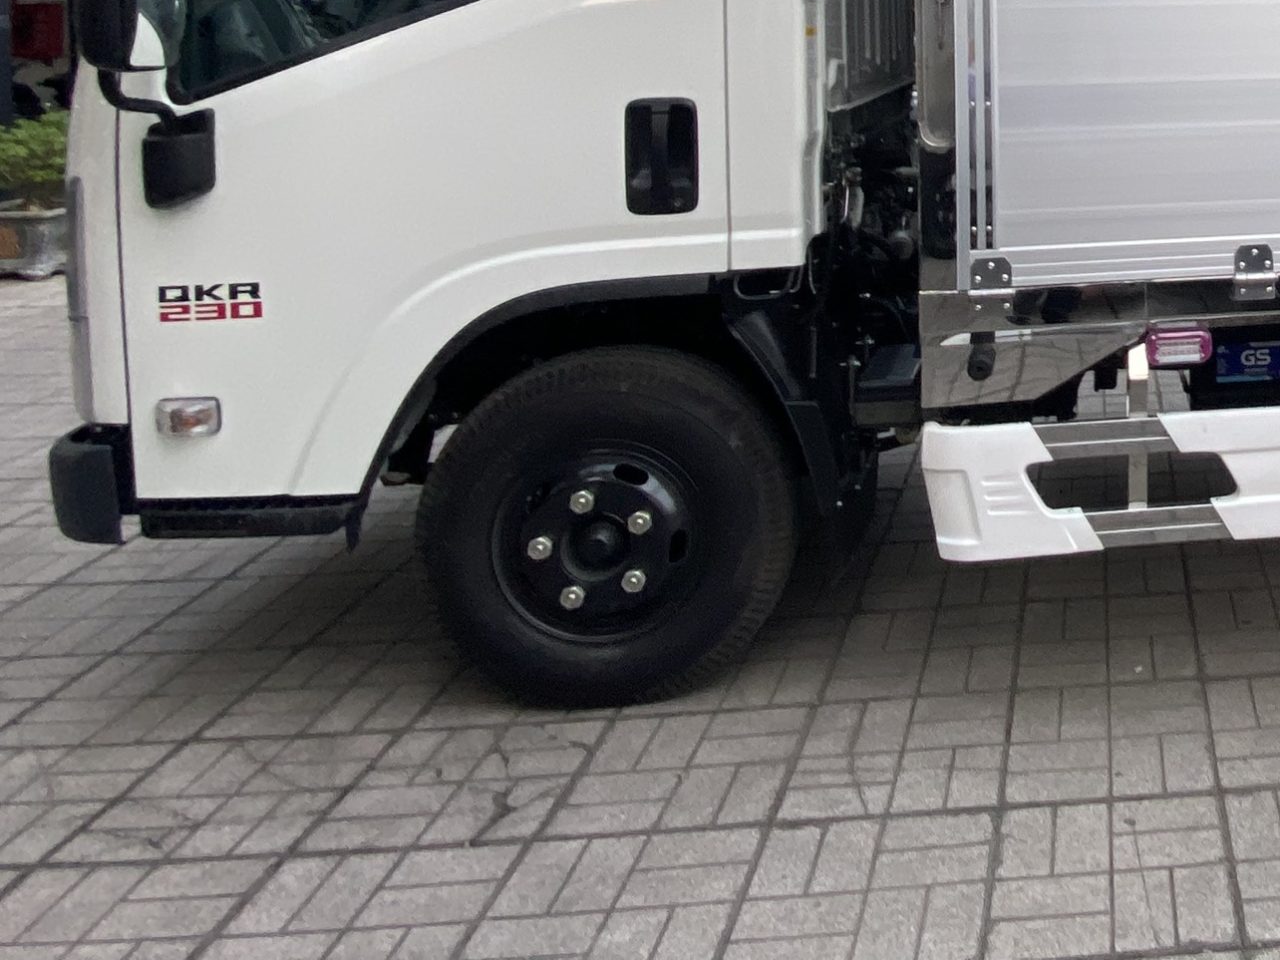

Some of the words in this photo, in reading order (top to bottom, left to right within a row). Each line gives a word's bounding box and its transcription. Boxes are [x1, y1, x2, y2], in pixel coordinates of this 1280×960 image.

[158, 282, 261, 303] QKR
[159, 301, 263, 322] 230
[1240, 348, 1271, 366] GS
